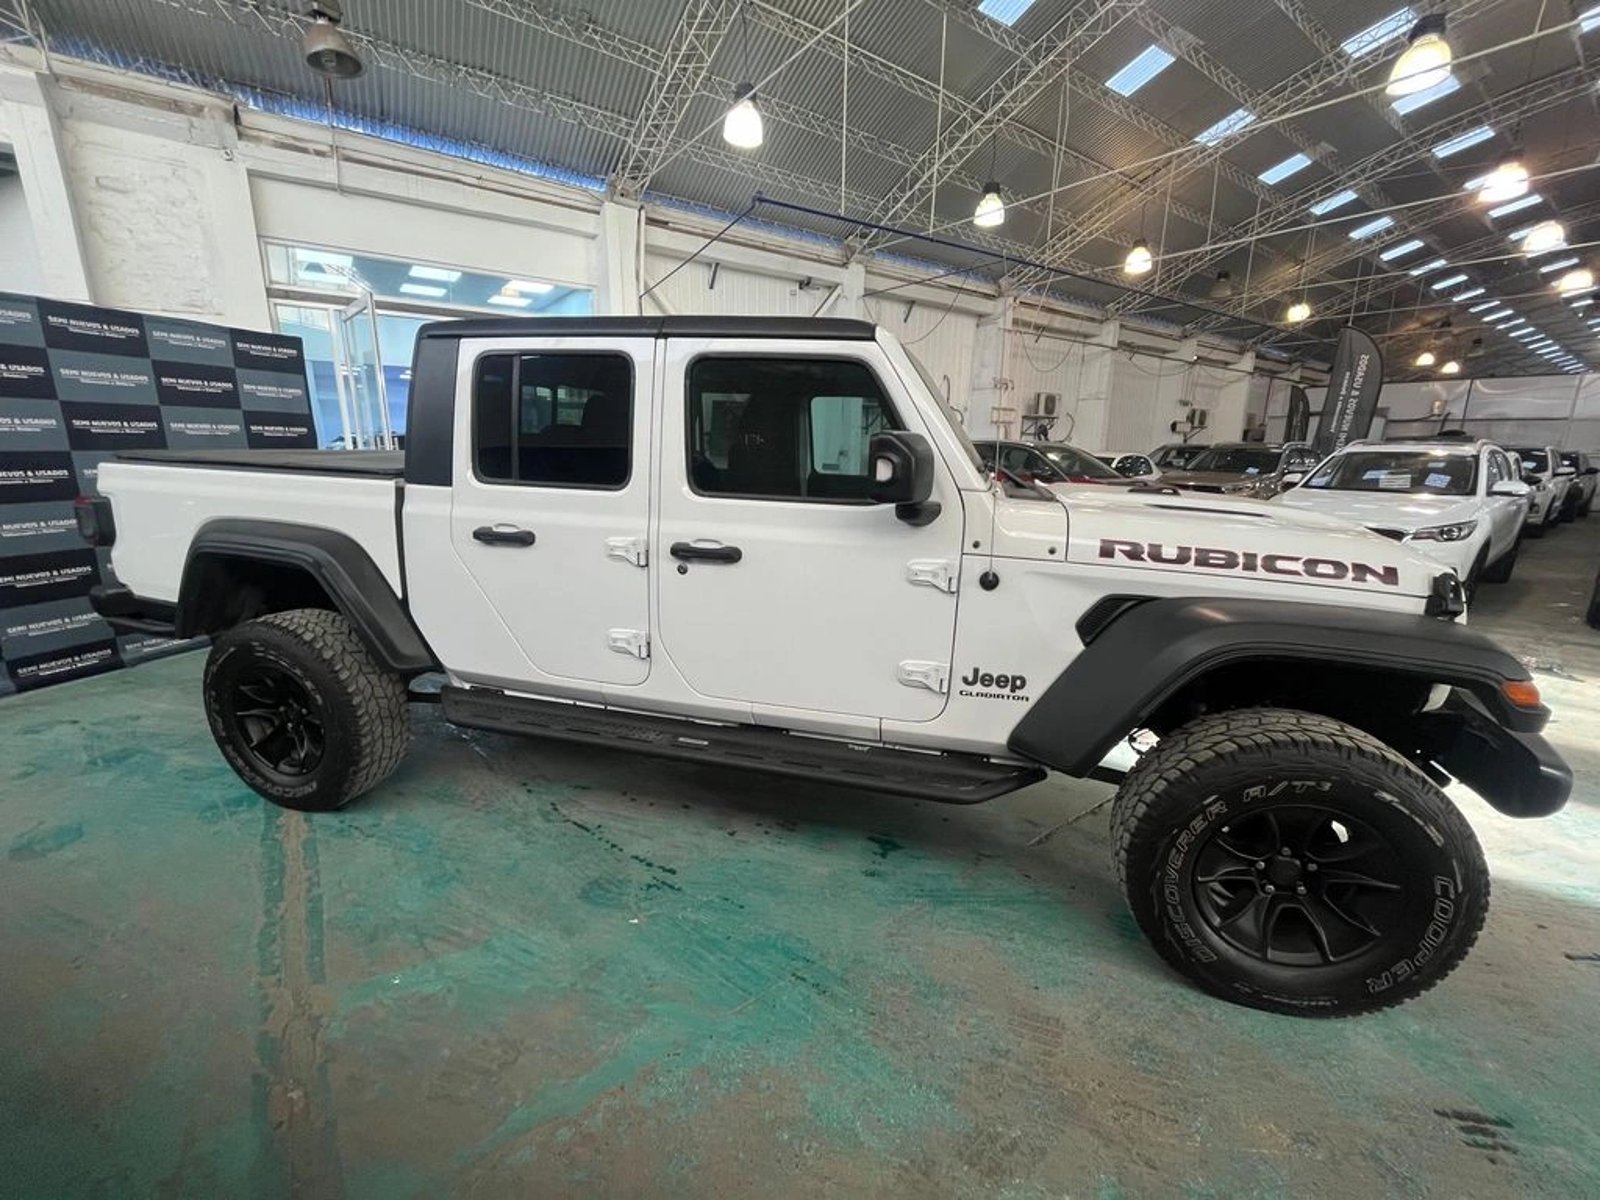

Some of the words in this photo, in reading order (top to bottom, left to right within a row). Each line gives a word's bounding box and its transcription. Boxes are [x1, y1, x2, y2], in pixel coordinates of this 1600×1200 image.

[8, 364, 45, 373] USADOS
[22, 417, 57, 426] USADOS
[72, 419, 90, 427] SEMI
[91, 420, 121, 428] NUEVOS
[35, 469, 69, 477] USADOS
[1099, 537, 1399, 586] RUBICON
[15, 570, 51, 580] NUEVOS
[60, 564, 92, 575] USADOS
[6, 624, 28, 634] SEMI
[28, 618, 63, 630] NUEVOS
[16, 665, 38, 675] SEMI
[39, 657, 73, 671] NUEVOS
[81, 648, 112, 661] USADOS
[962, 667, 1027, 693] Jeep
[959, 690, 1030, 702] GLADIATOR
[1162, 799, 1229, 964] DISCOVERER
[1365, 875, 1455, 993] COOPER
